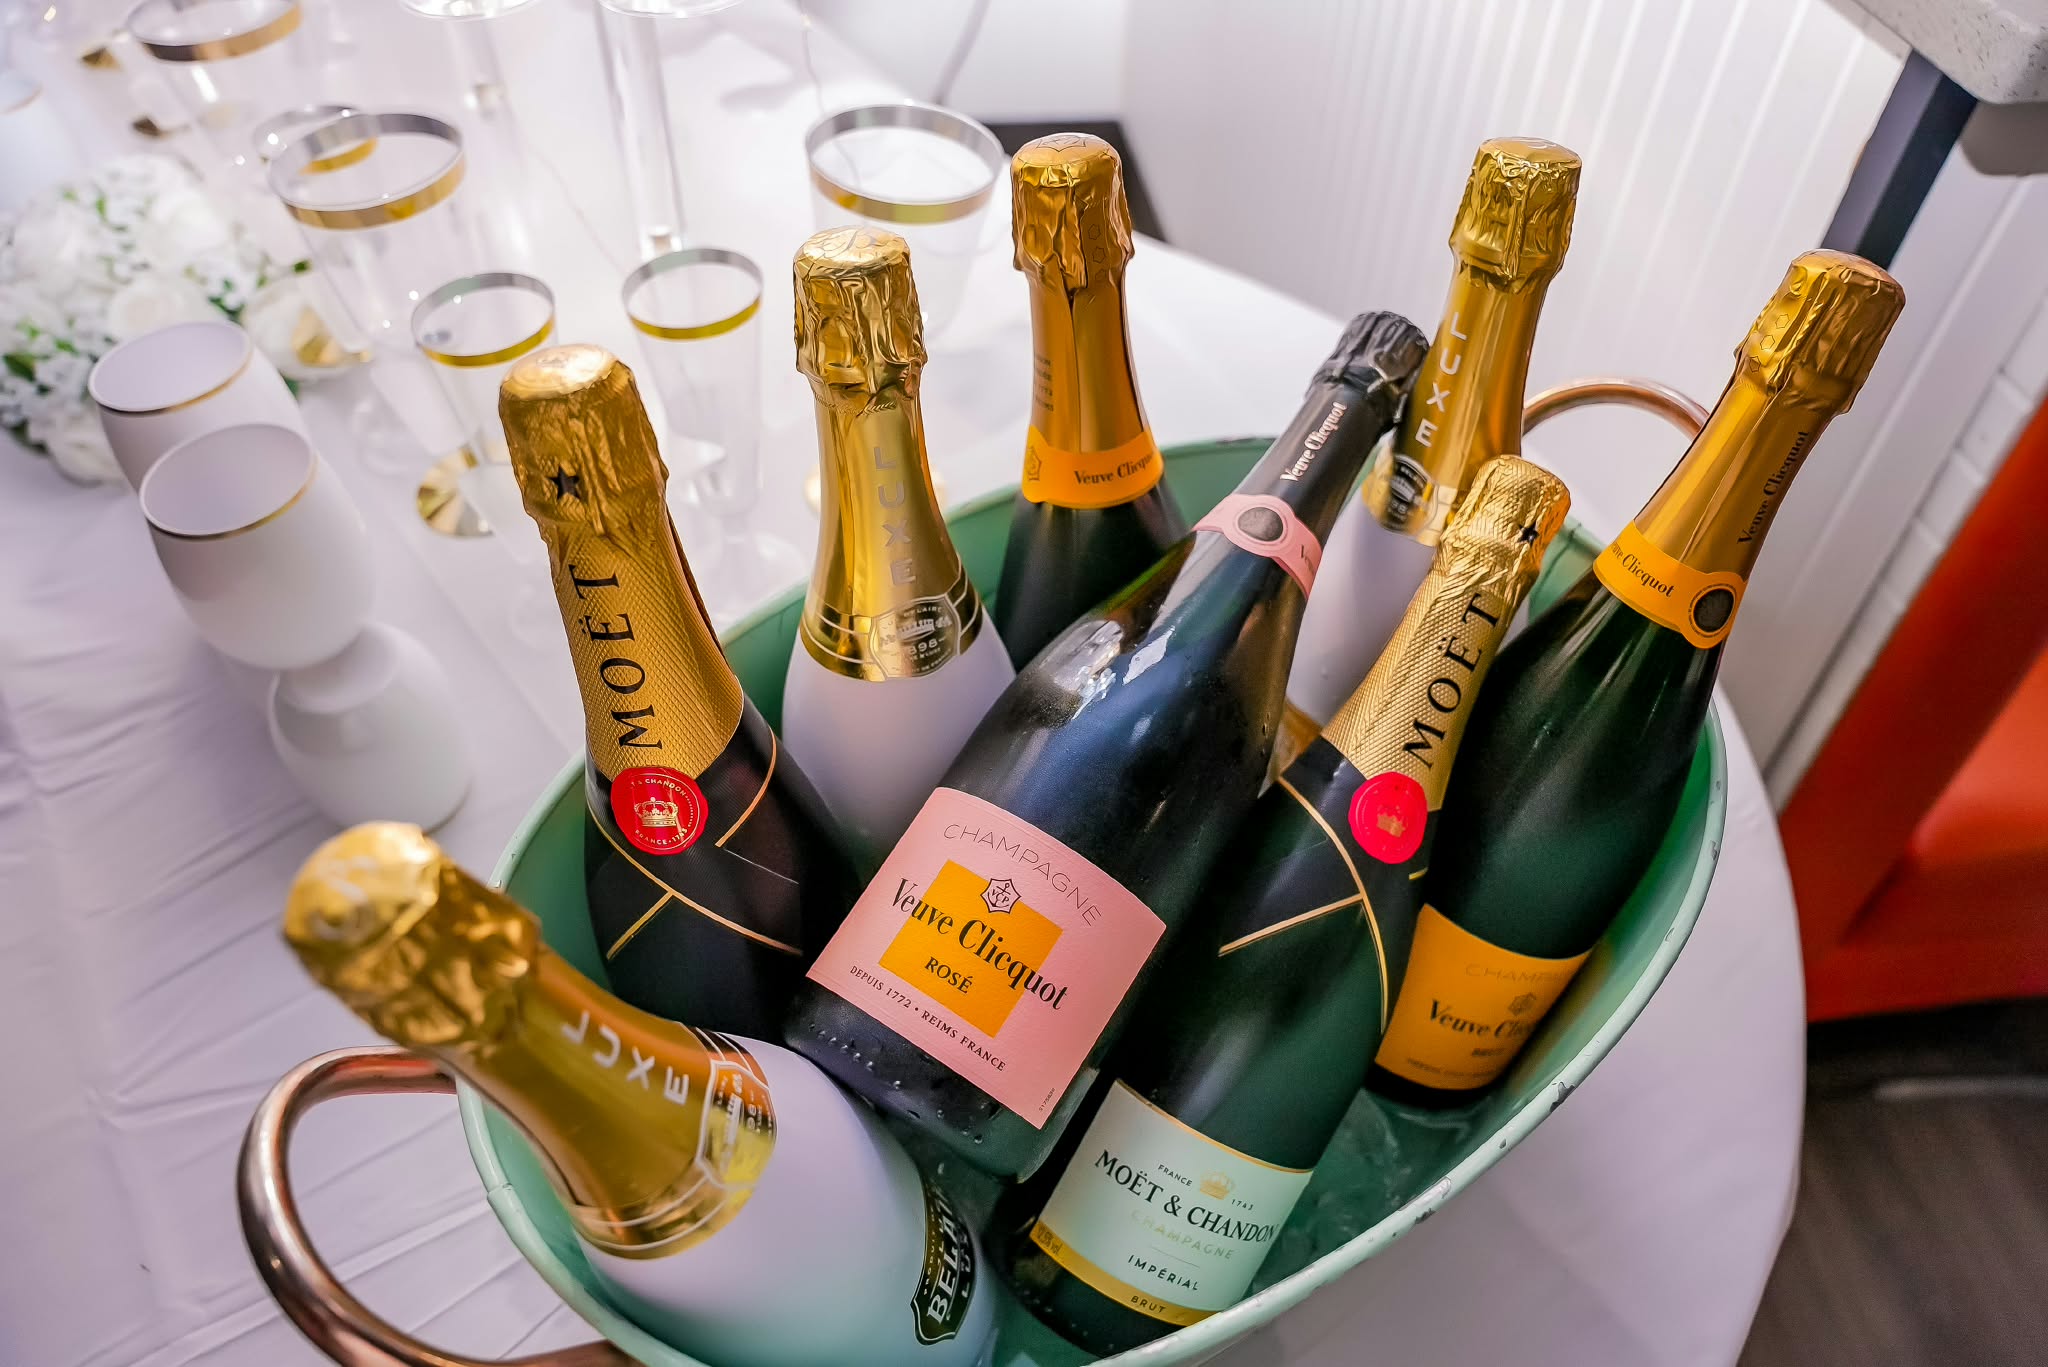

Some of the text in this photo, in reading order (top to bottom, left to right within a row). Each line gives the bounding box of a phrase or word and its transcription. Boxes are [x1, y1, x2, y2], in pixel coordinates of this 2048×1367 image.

[1415, 312, 1467, 448] LUXE
[1073, 469, 1114, 485] Veuve
[1280, 401, 1347, 481] Veuve Clicquot
[873, 446, 917, 587] LUXE
[1737, 431, 1809, 545] Veuve Clicquot
[1622, 553, 1675, 598] Clicquot
[568, 564, 663, 750] MOËT
[1402, 592, 1501, 769] MOËT
[645, 778, 687, 797] CHANDON
[942, 822, 1103, 928] CHAMPAGNE
[891, 877, 1069, 1011] Veuve Clicquot
[924, 956, 974, 995] ROSÉ
[561, 1010, 690, 1106] LUXE
[850, 965, 1007, 1072] DEPUIS 1772 REIMS FRANCE
[1430, 998, 1491, 1037] Veuve
[1094, 1148, 1280, 1242] MOËT & CHANDON
[1157, 1164, 1193, 1187] FRANCE
[1127, 1253, 1200, 1292] IMPÉRIAL
[1131, 1209, 1235, 1260] CHAMPAGNE
[1130, 1295, 1167, 1315] BRUT
